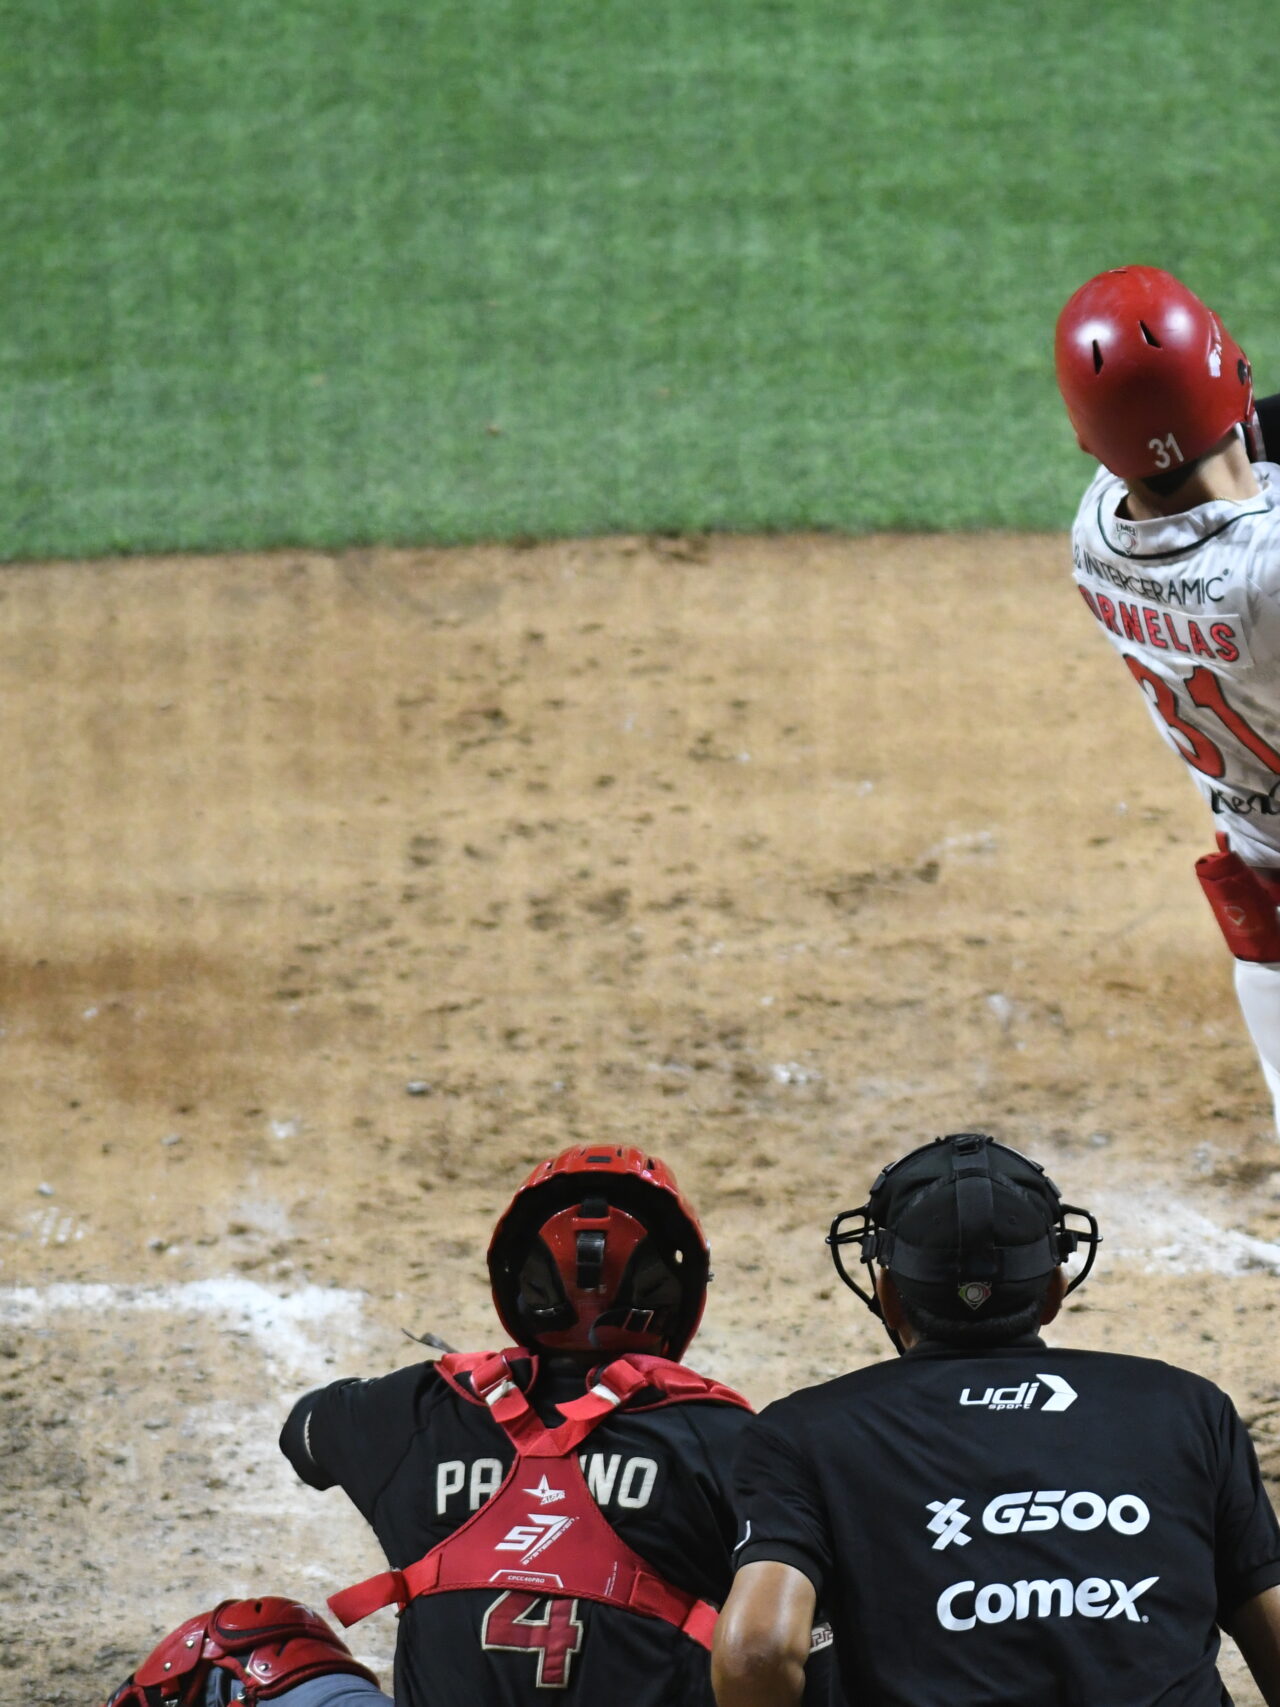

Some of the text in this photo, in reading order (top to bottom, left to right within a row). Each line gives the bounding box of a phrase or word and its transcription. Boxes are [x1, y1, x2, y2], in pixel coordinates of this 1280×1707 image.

[1149, 432, 1184, 468] 31
[960, 1382, 1040, 1405] udi
[988, 1402, 1031, 1411] sport
[982, 1490, 1150, 1536] G500
[936, 1576, 1160, 1631] Comex
[481, 1589, 584, 1689] 4
